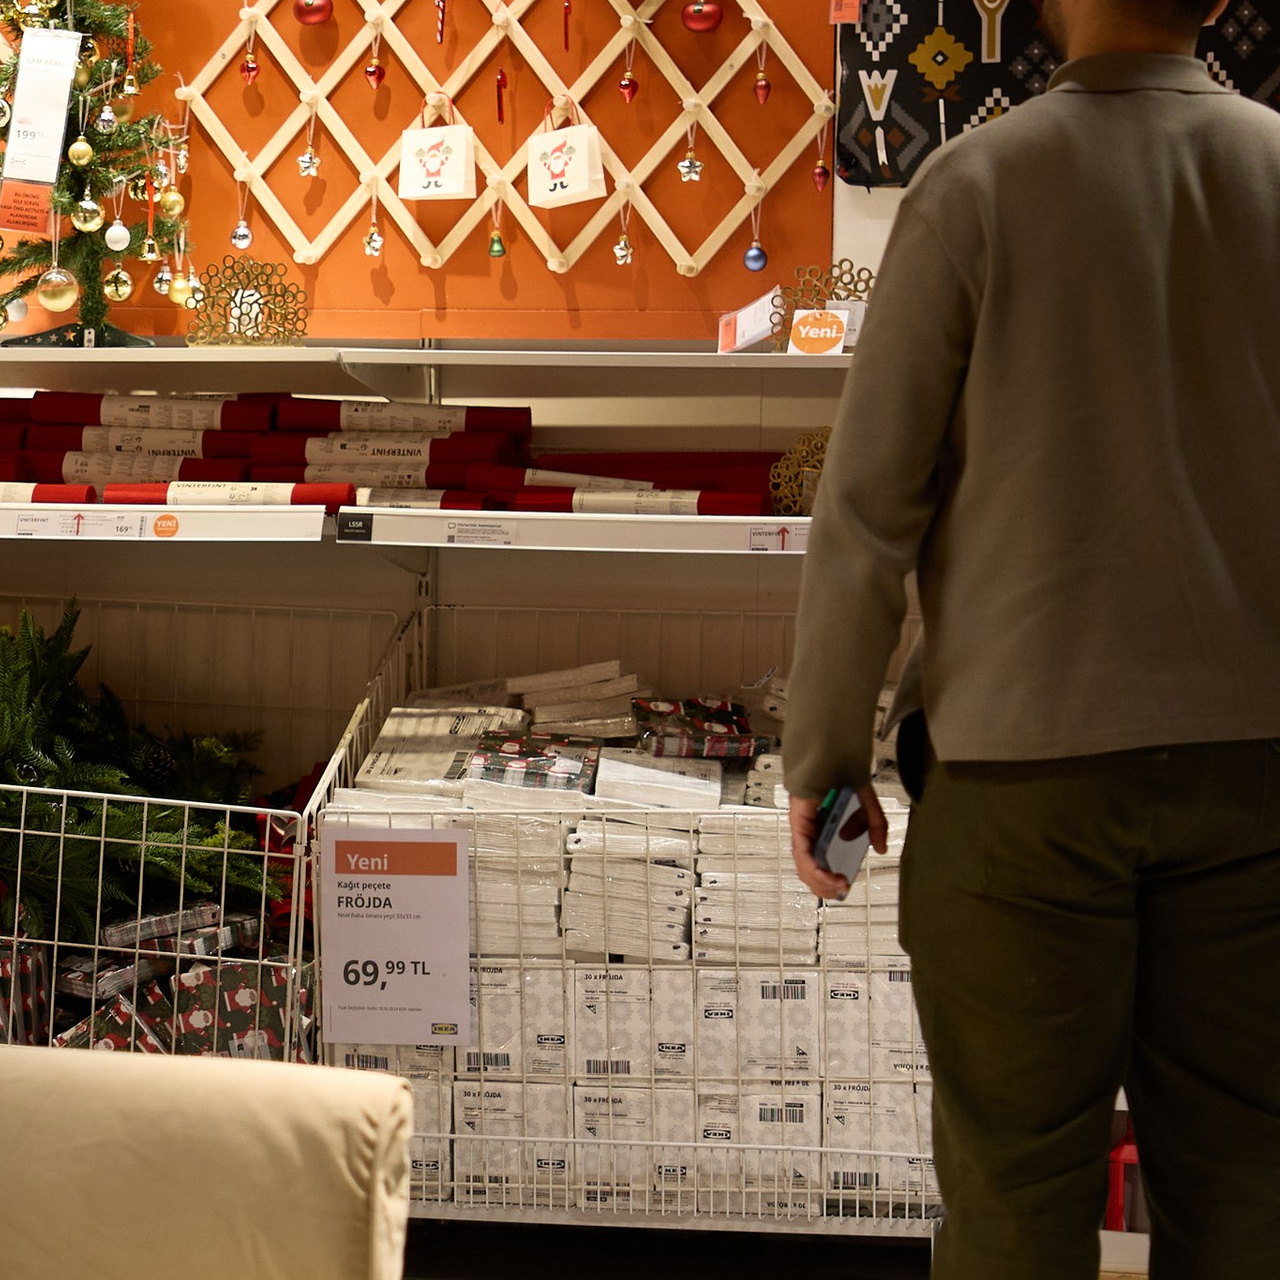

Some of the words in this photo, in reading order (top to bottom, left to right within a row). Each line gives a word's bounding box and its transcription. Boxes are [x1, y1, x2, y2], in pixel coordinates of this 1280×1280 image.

[16, 130, 36, 140] 199
[798, 324, 837, 339] Yeni
[371, 447, 422, 457] VINTERFINT
[115, 525, 129, 533] 169
[346, 853, 389, 871] Yeni
[337, 880, 360, 891] Kağıt
[362, 882, 392, 892] peçete
[337, 893, 393, 909] FRÖJDA
[411, 960, 431, 976] TL
[584, 973, 592, 981] 30
